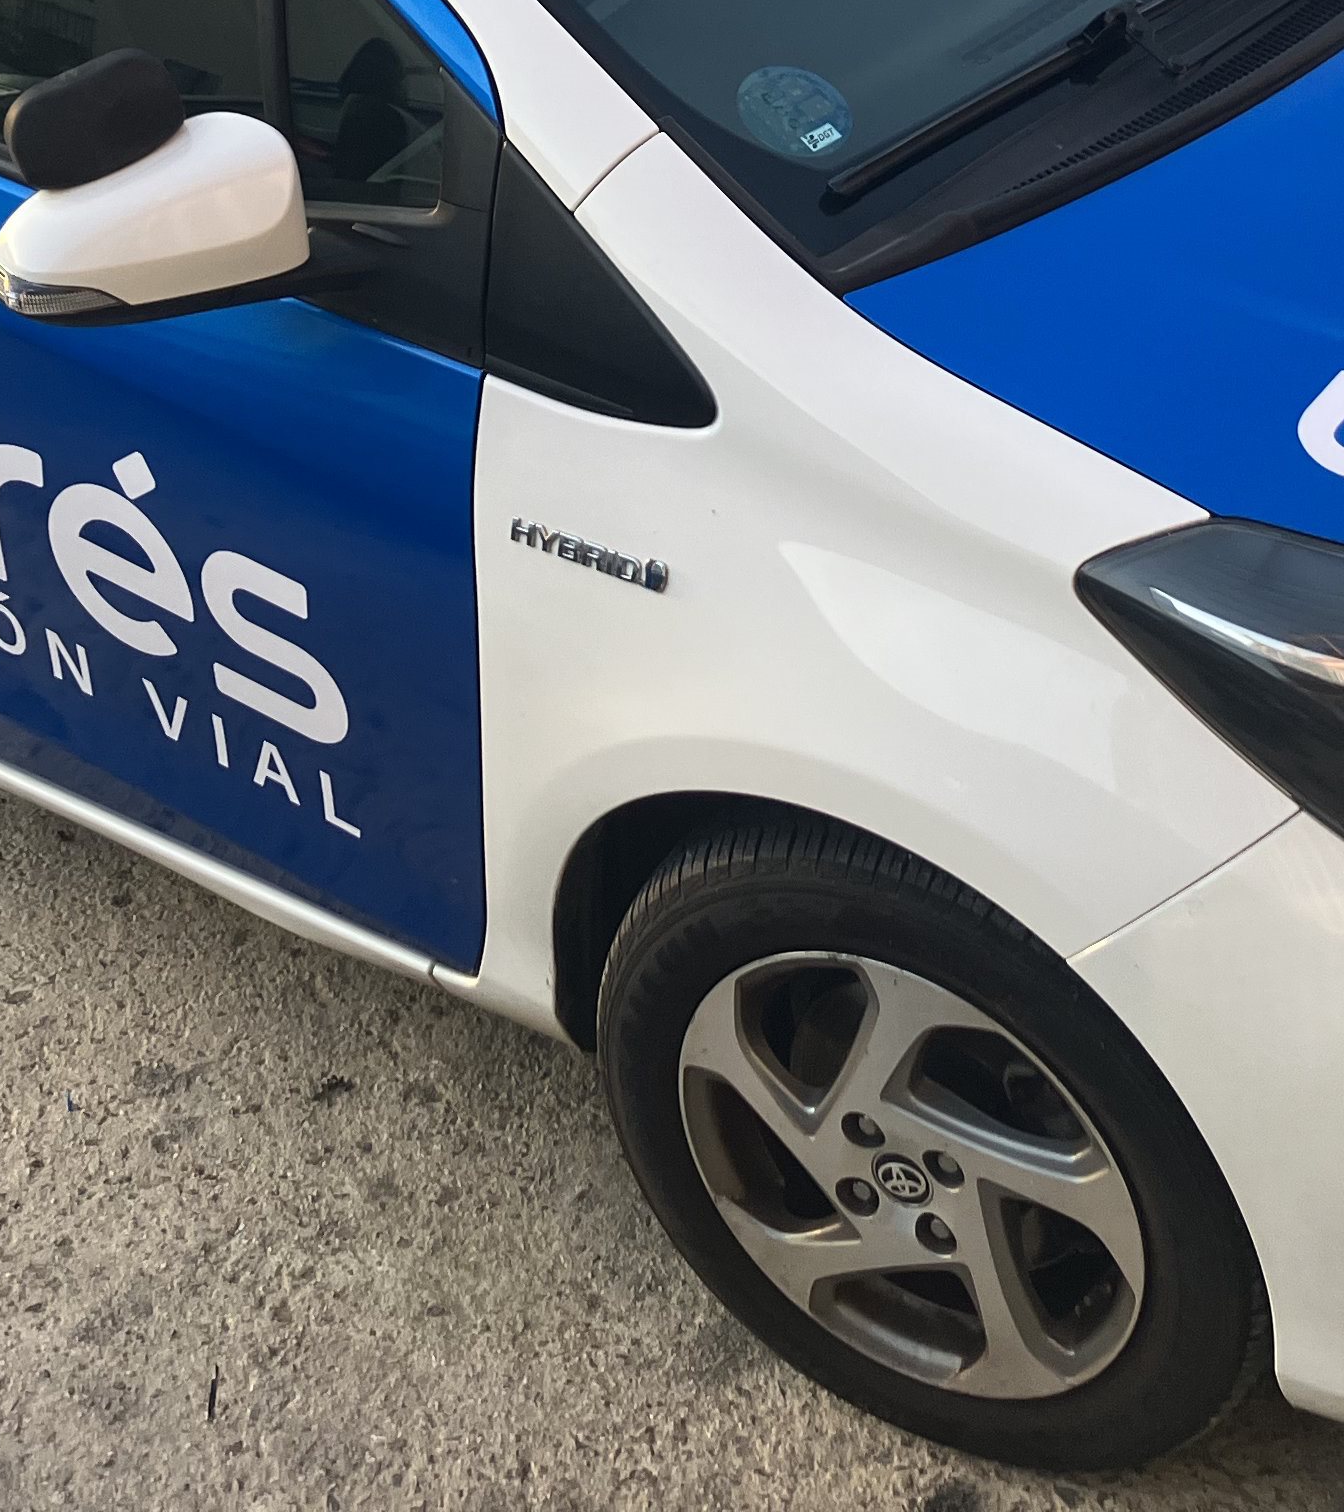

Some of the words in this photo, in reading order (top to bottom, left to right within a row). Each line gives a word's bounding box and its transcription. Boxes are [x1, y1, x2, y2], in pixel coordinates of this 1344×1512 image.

[817, 127, 835, 143] DGT
[510, 515, 645, 584] HYBRID
[141, 677, 362, 839] VIAL
